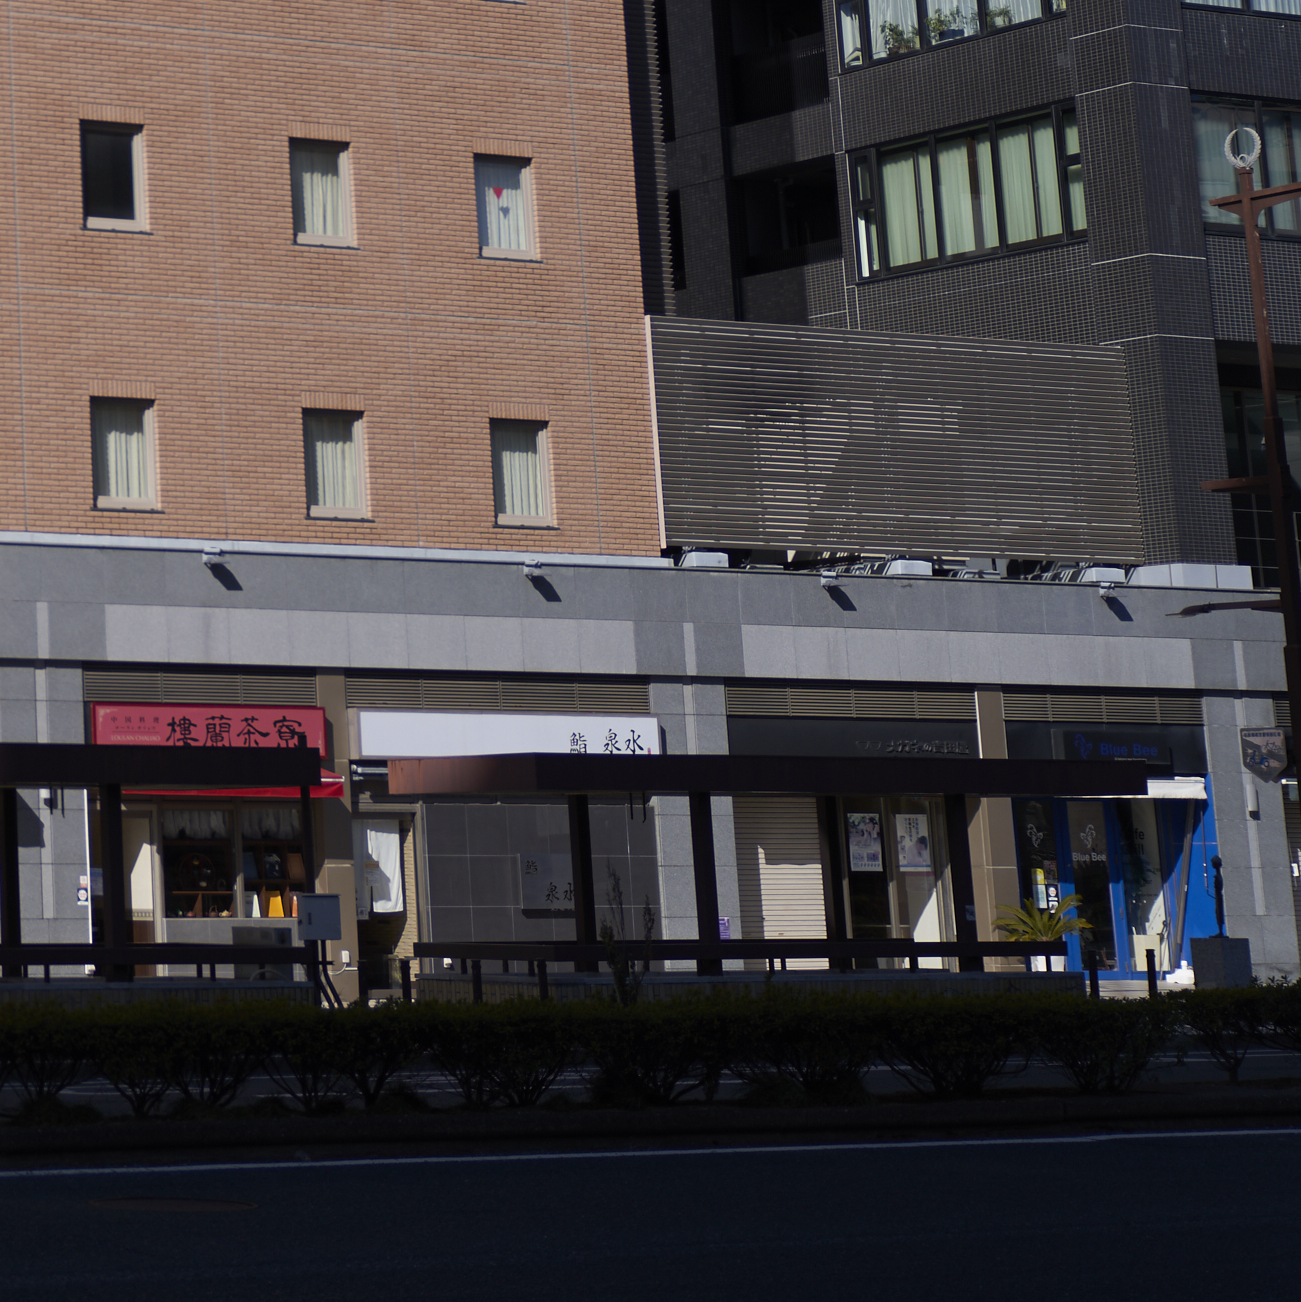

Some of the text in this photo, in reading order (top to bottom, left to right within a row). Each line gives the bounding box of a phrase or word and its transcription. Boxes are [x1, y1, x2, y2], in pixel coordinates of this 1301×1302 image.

[603, 729, 644, 754] 泉水
[1100, 743, 1158, 757] Blue Bee
[1072, 852, 1107, 862] Blue Bee
